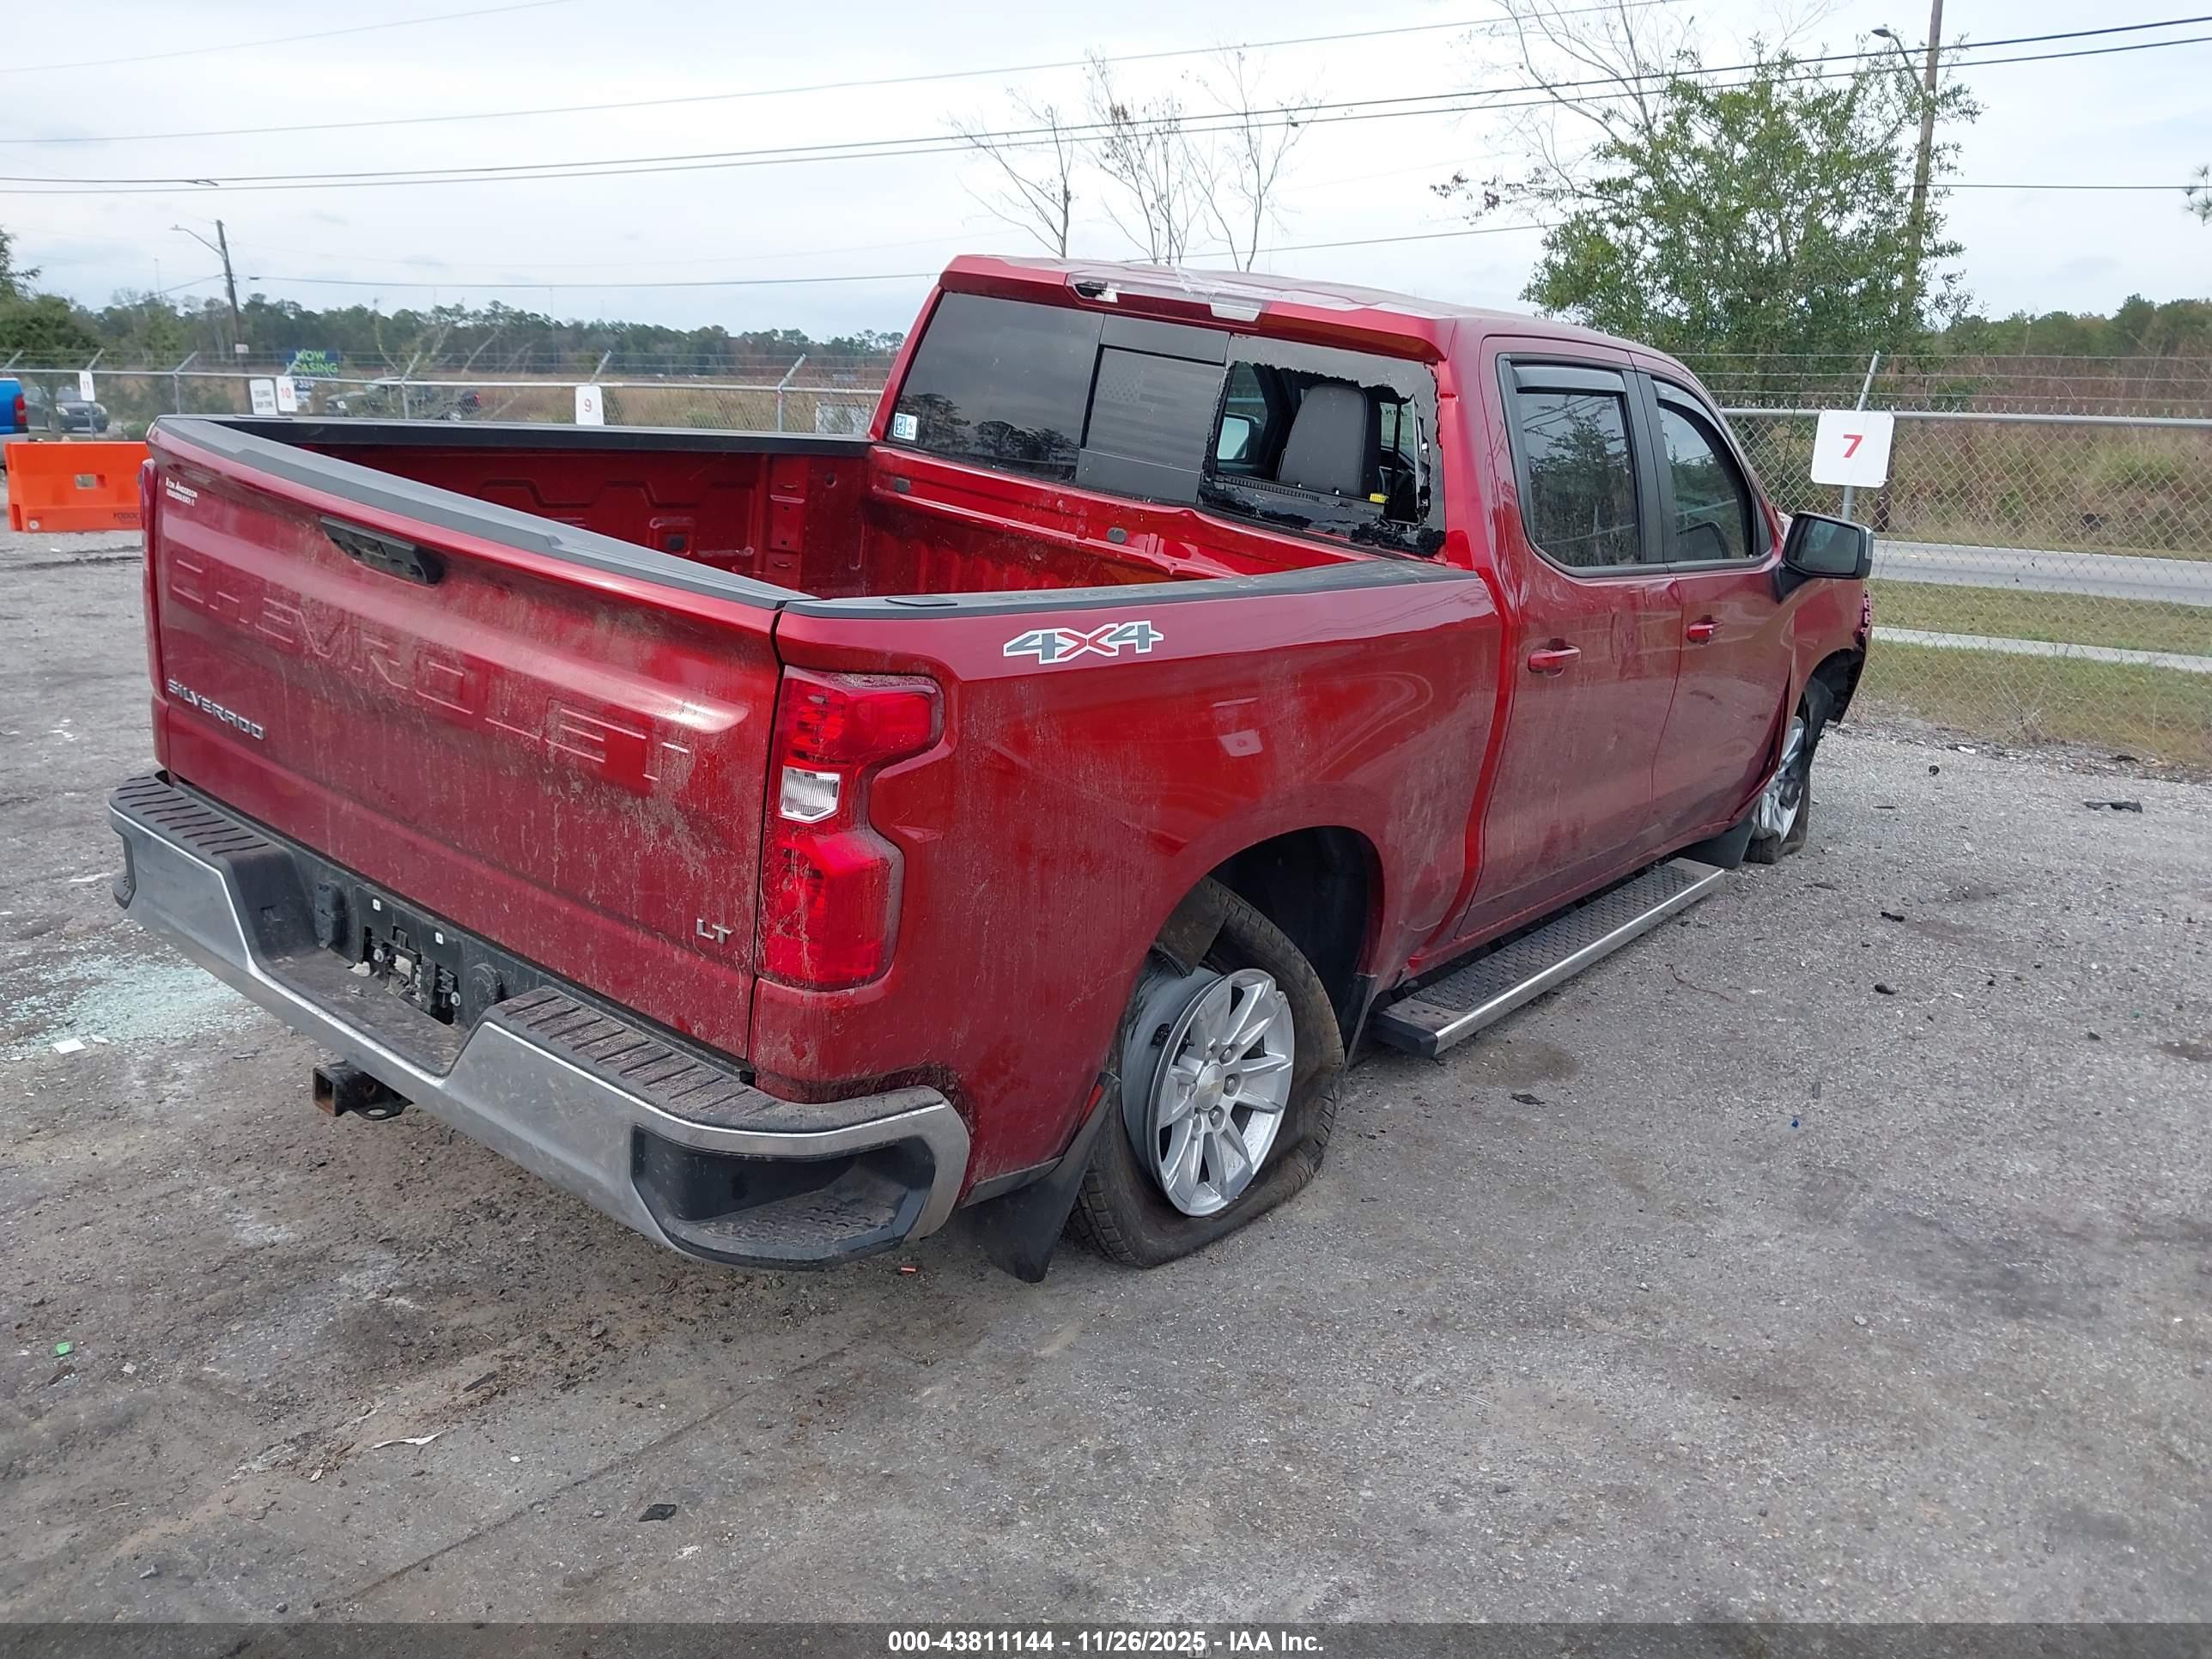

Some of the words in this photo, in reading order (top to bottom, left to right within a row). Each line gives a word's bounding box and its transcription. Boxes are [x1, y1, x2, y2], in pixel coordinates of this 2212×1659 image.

[295, 349, 326, 362] NOW
[281, 386, 292, 399] 10
[584, 398, 592, 413] 9
[1843, 434, 1863, 458] 7
[168, 555, 692, 782] CHEVROLET
[167, 678, 265, 741] SILVERADO
[696, 918, 734, 945] LT
